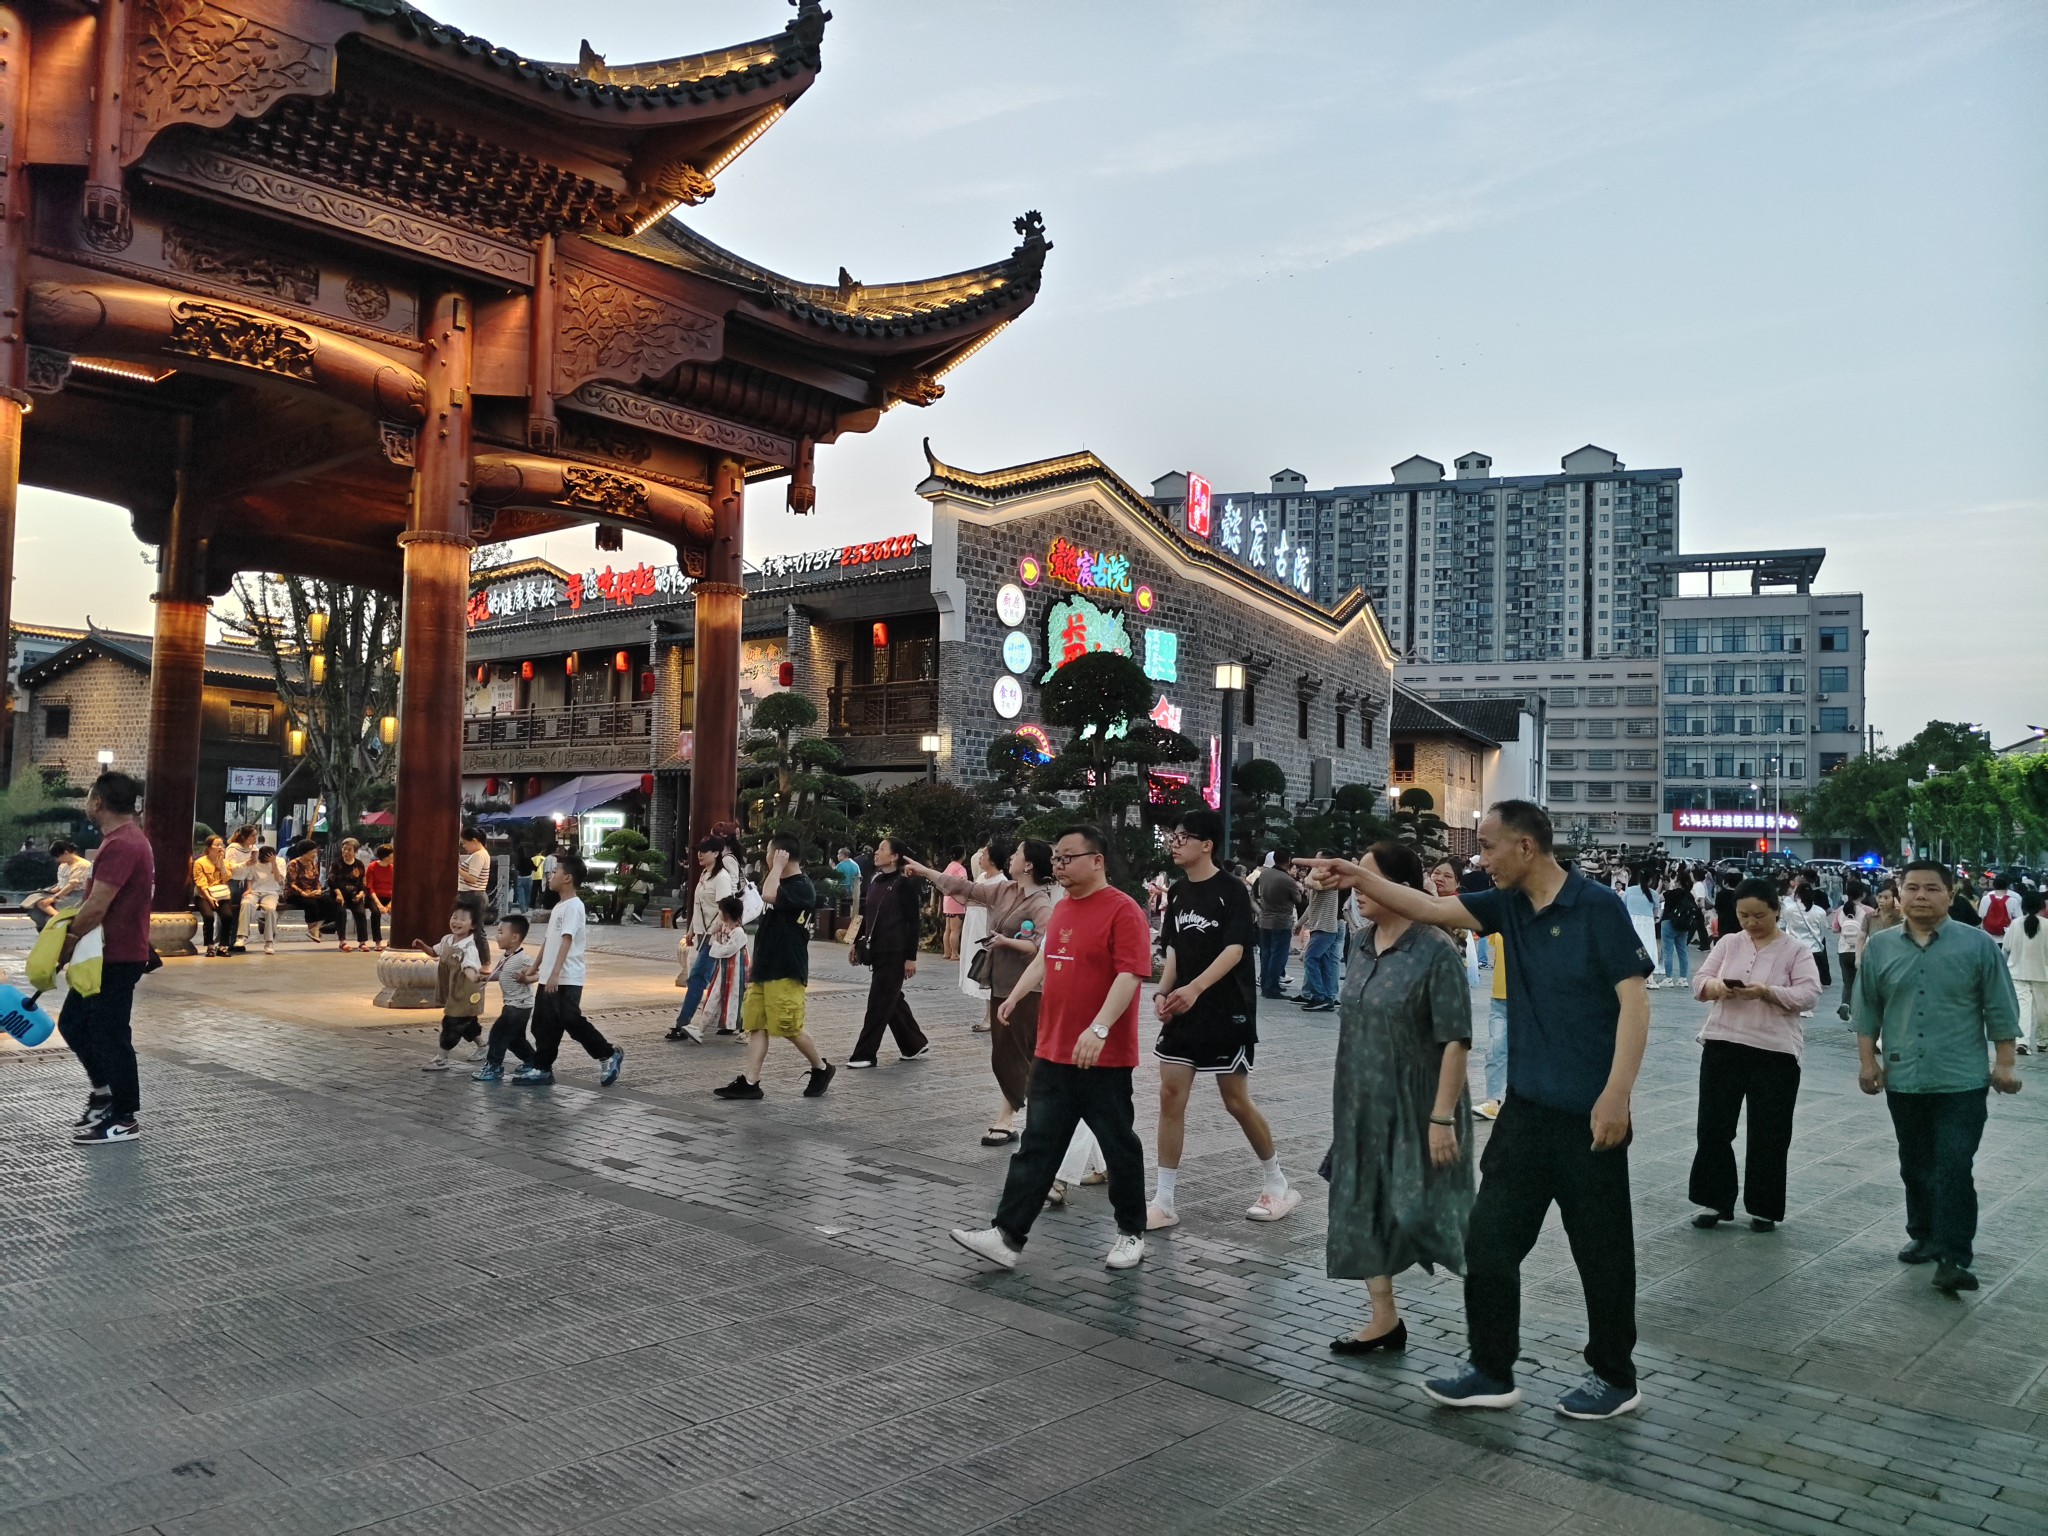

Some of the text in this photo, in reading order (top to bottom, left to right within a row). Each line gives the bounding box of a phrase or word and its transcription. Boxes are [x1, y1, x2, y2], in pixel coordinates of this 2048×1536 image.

[1680, 814, 1798, 828] 大码头街道便民服务中心
